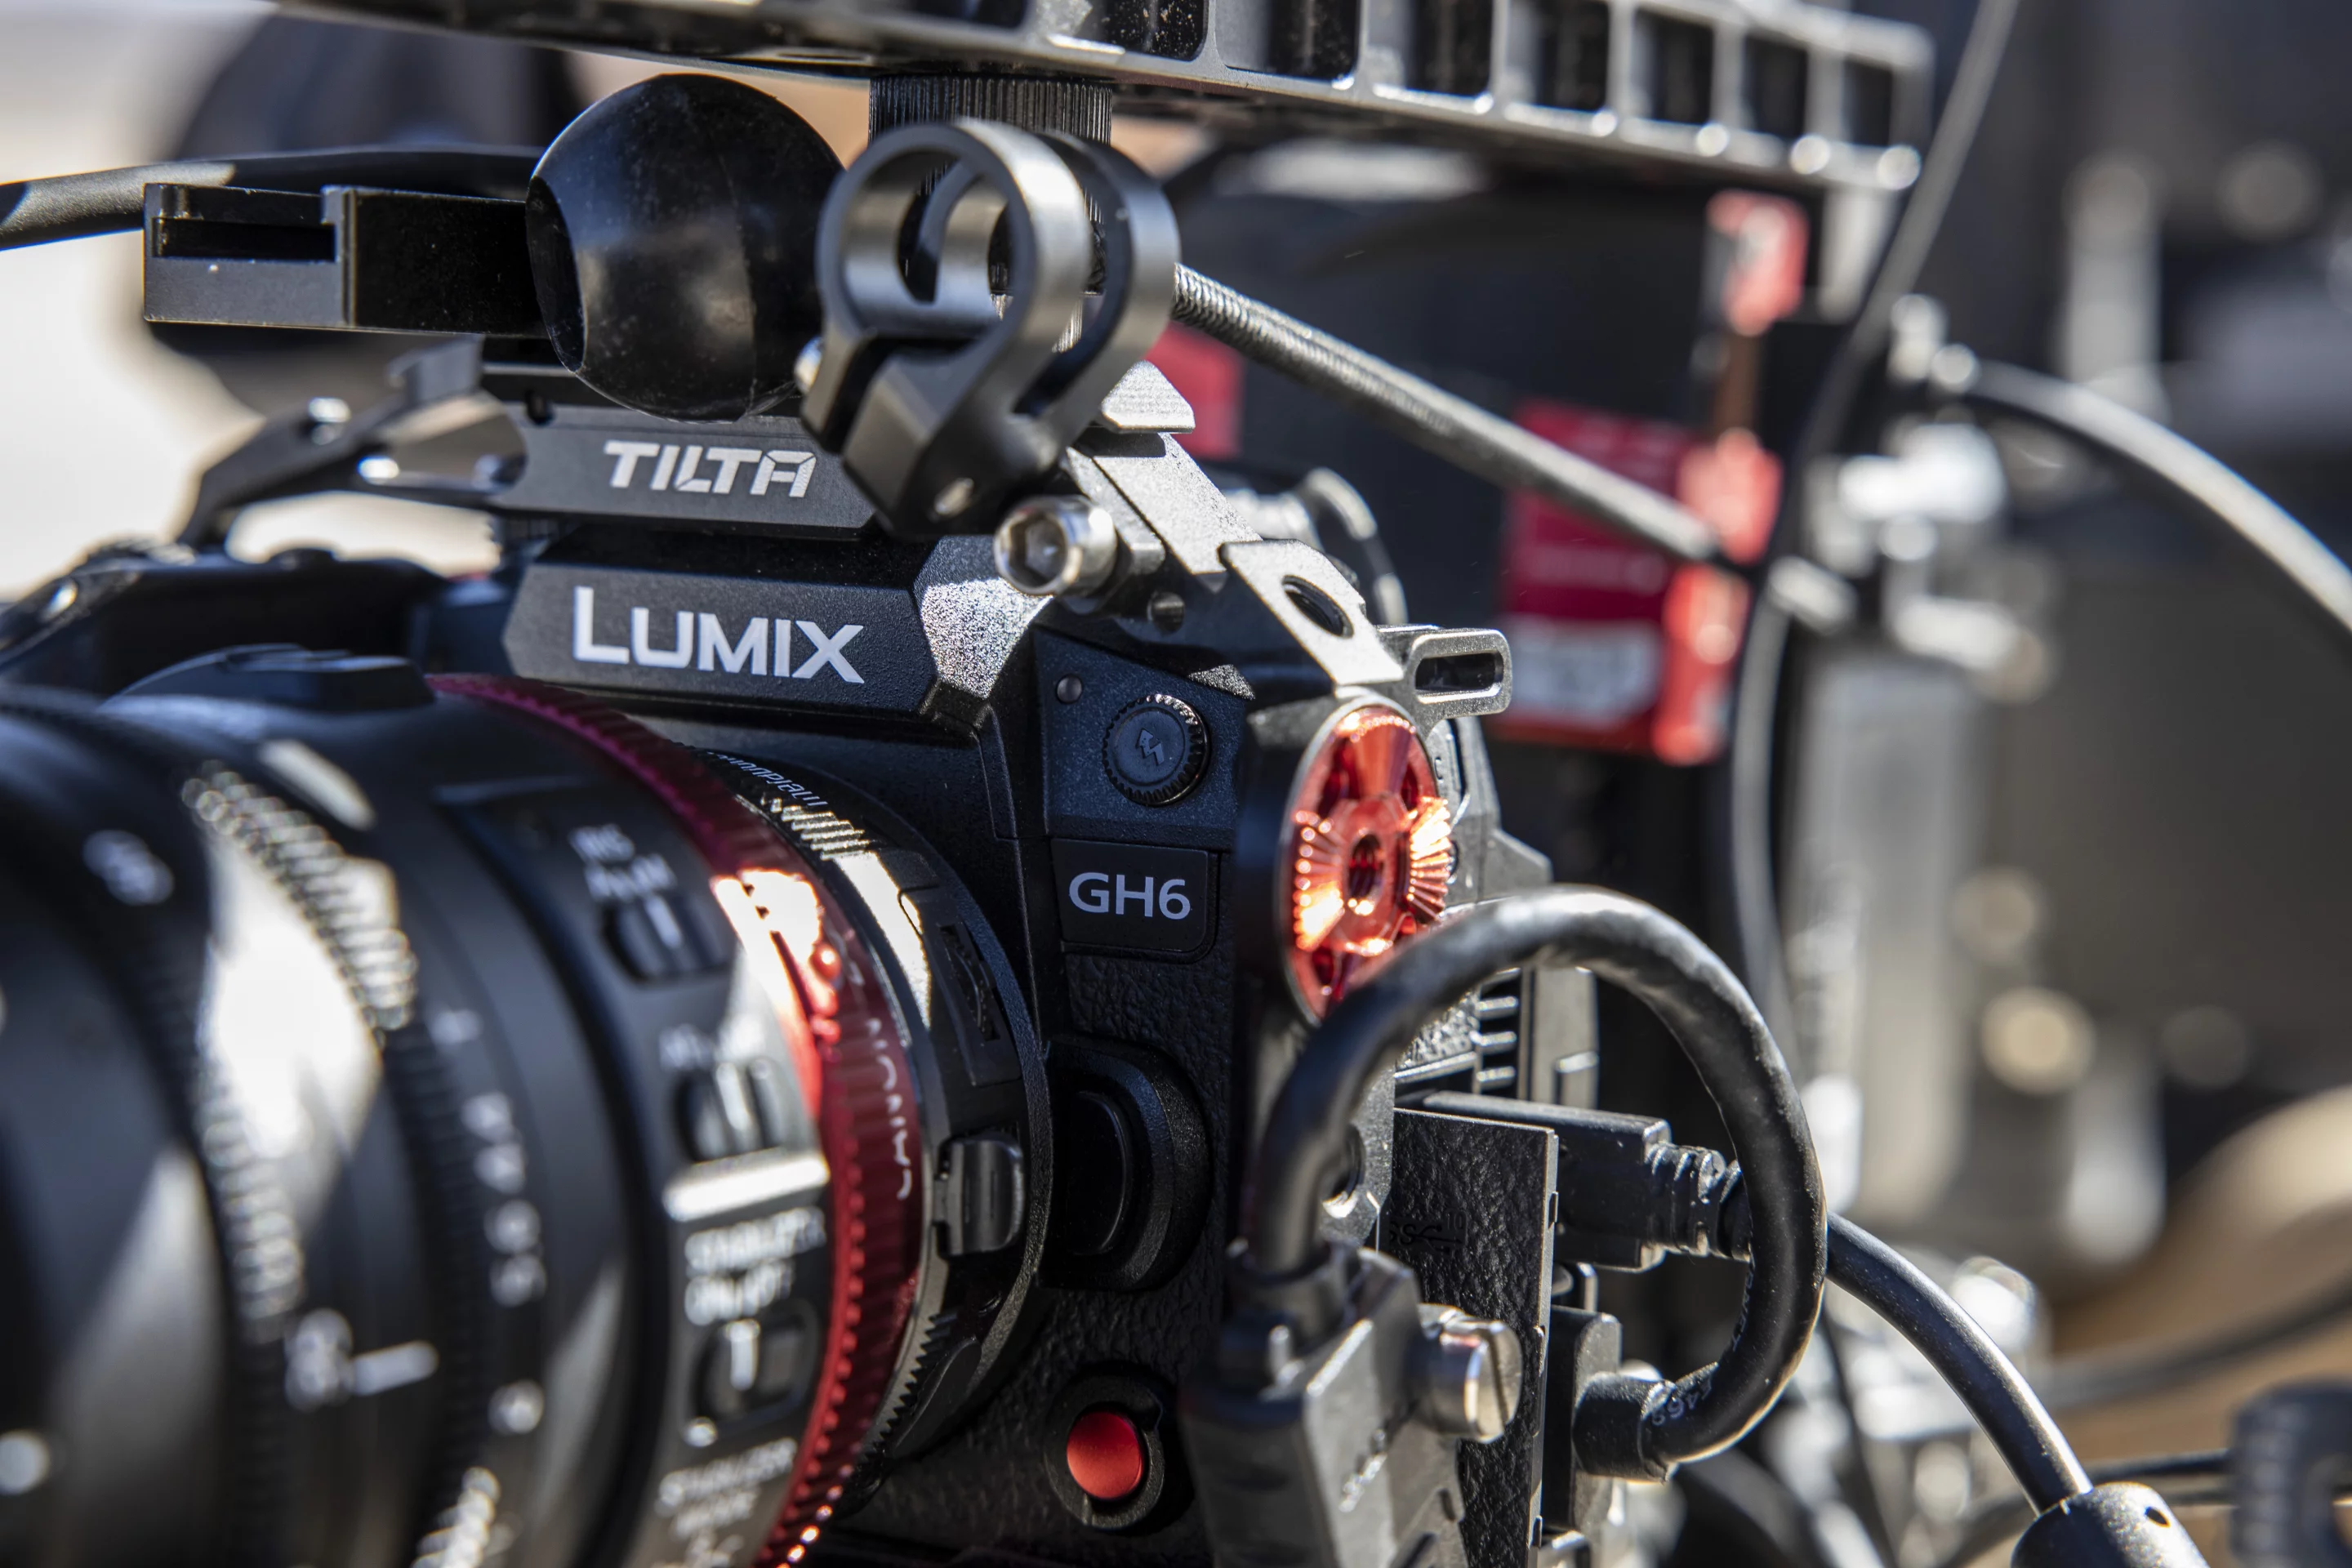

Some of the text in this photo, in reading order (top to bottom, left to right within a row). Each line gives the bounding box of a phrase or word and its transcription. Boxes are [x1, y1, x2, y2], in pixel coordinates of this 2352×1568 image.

[604, 439, 817, 498] TILTA
[573, 586, 865, 684] LUMIX
[1068, 871, 1192, 920] GH6
